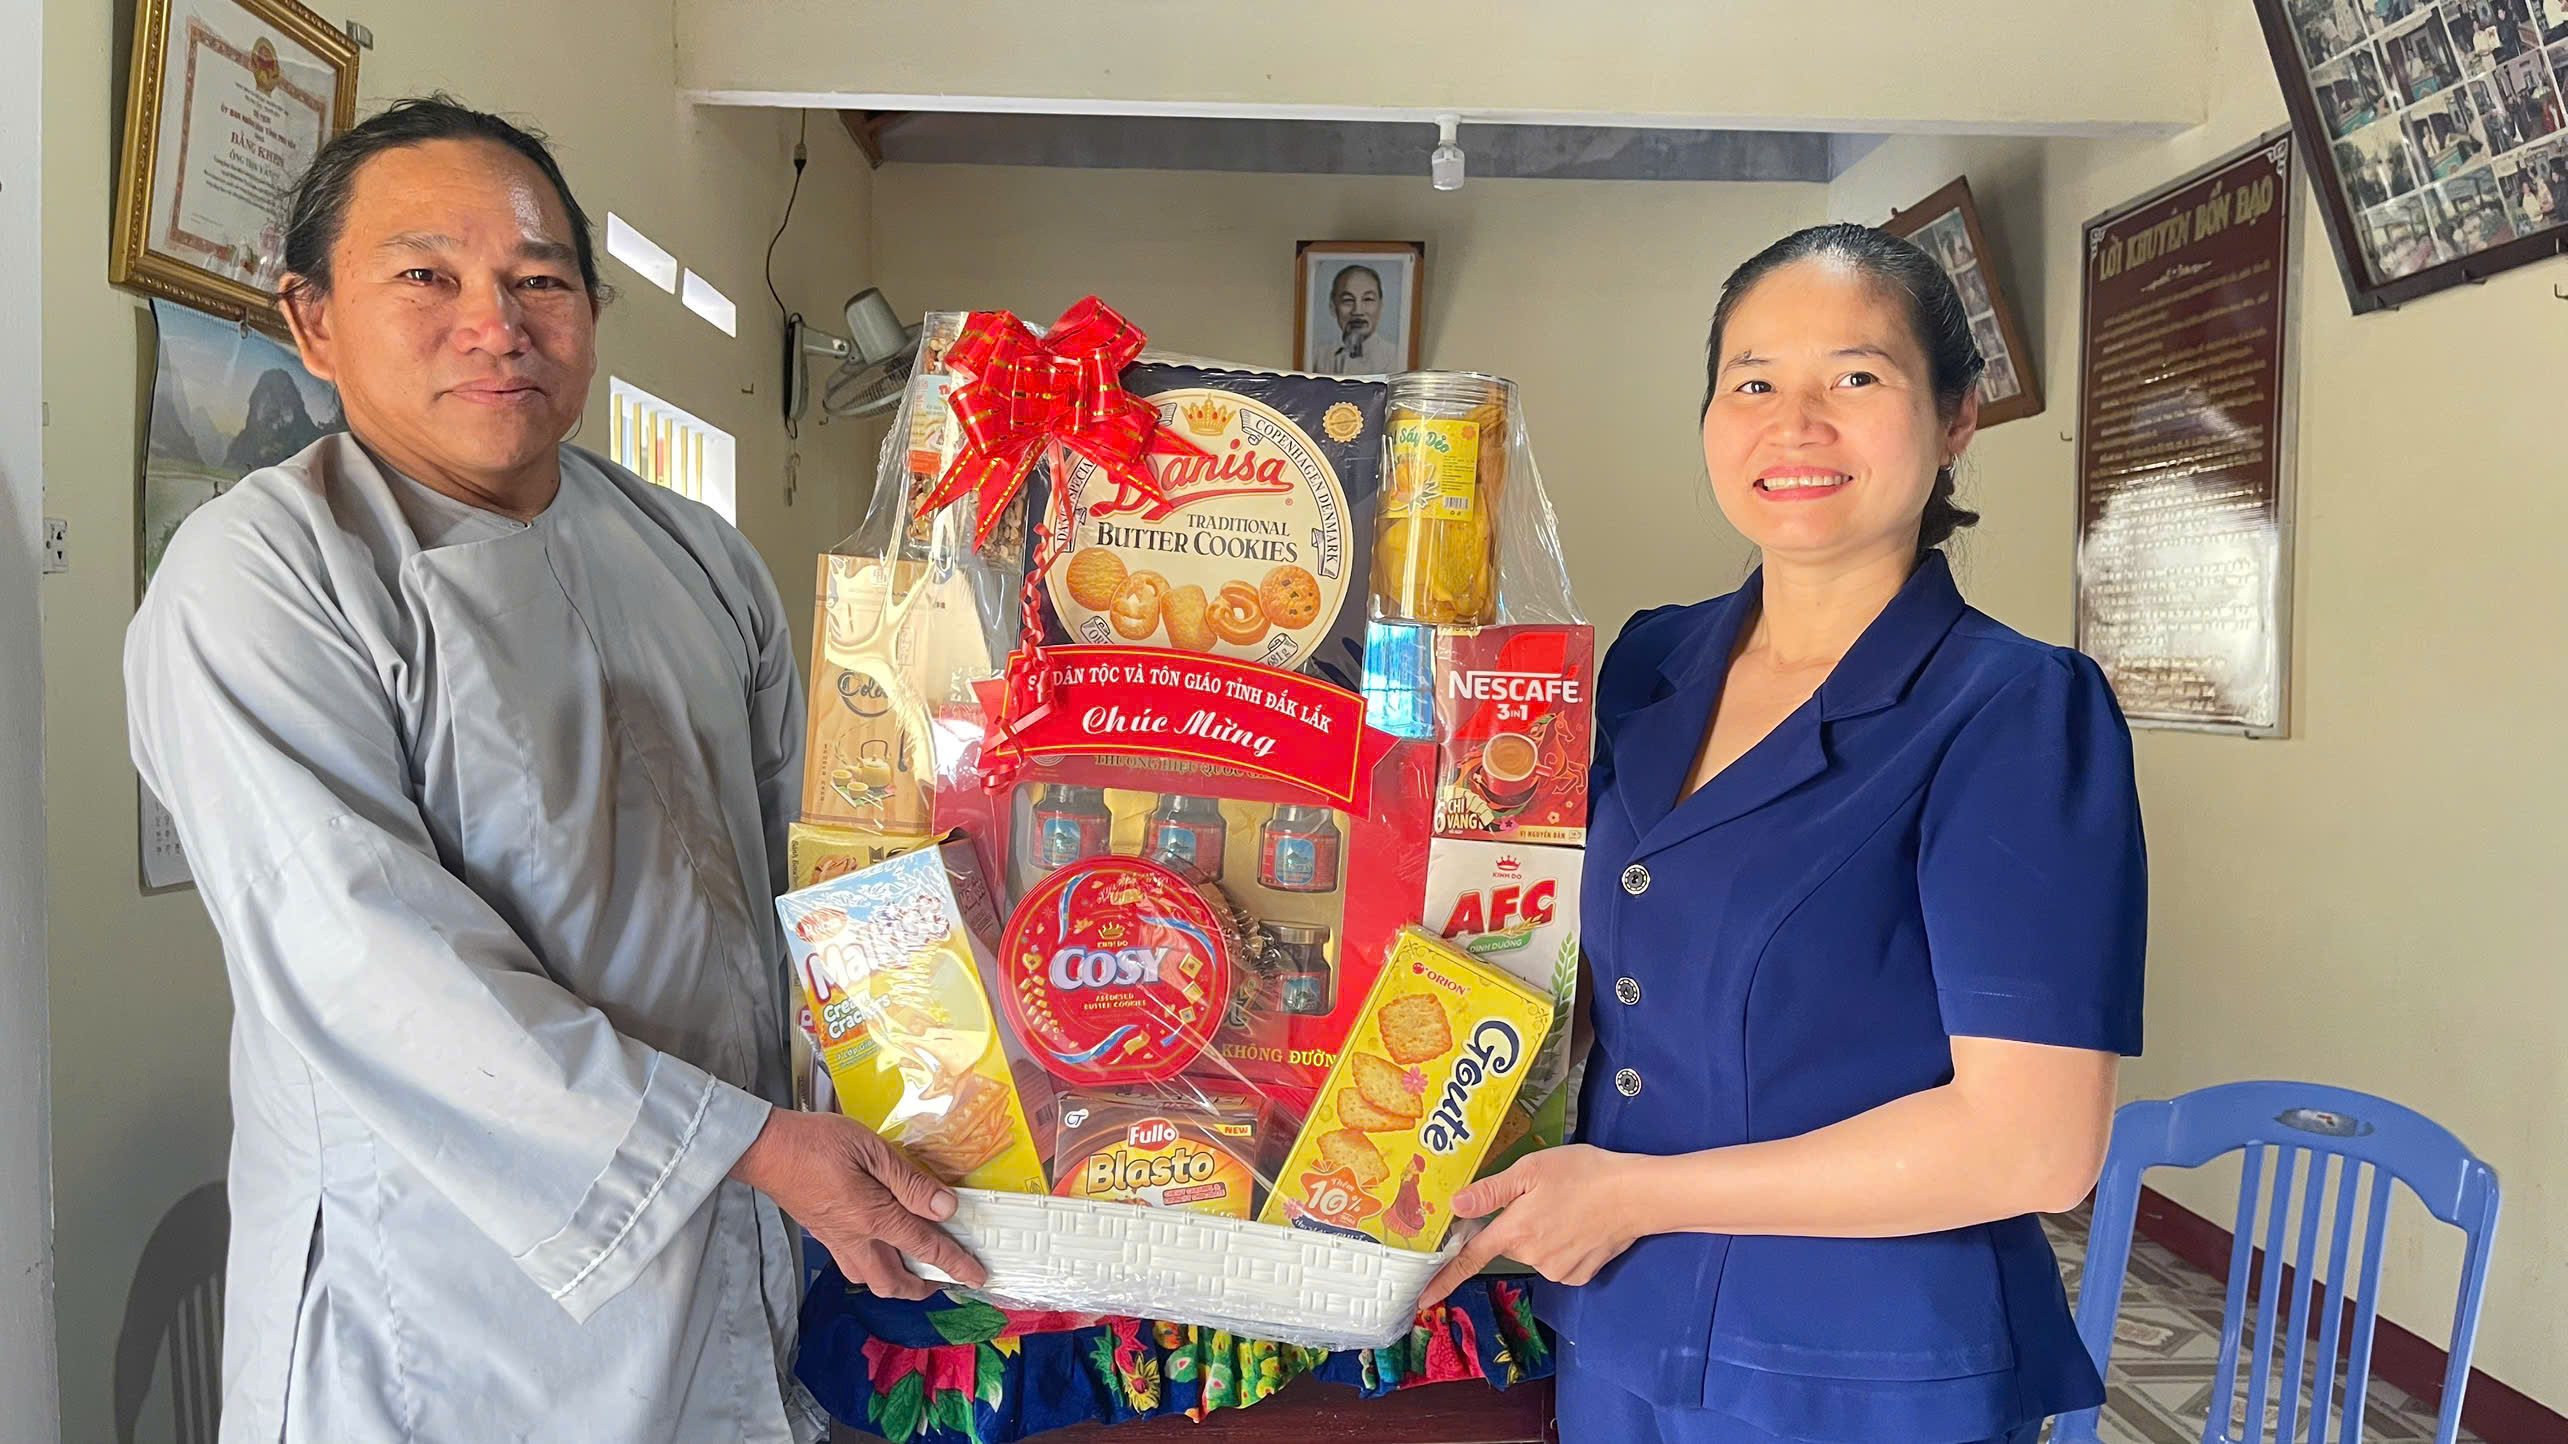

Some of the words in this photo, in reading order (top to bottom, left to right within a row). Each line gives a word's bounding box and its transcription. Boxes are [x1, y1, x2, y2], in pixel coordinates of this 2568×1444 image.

[1255, 418, 1325, 493] COPENHAGEN
[1317, 493, 1339, 563] DENMARK
[1096, 521, 1190, 554] BUTTER
[1193, 530, 1299, 563] COOKIES
[1187, 513, 1291, 537] TRADITIONAL
[1052, 665, 1084, 686] DÂN
[1089, 664, 1120, 688] TỘC
[1127, 663, 1145, 684] VÀ
[1150, 665, 1180, 687] TÔN
[1184, 671, 1222, 694] GIÁO
[1226, 676, 1263, 705] TỈNH
[1265, 689, 1298, 718] ĐẮK
[1299, 703, 1336, 734] LẮK
[1082, 704, 1169, 735] Chúc
[1173, 709, 1278, 758] Mừng
[1441, 879, 1557, 939] AFC
[1049, 946, 1169, 992] COSY
[1427, 969, 1467, 996] ORION
[1222, 1042, 1283, 1063] KHÔNG
[1289, 1048, 1337, 1068] ĐƯỜN
[1129, 1124, 1177, 1146] Fullo
[1223, 1126, 1249, 1135] NEW
[1087, 1147, 1215, 1195] Blasto
